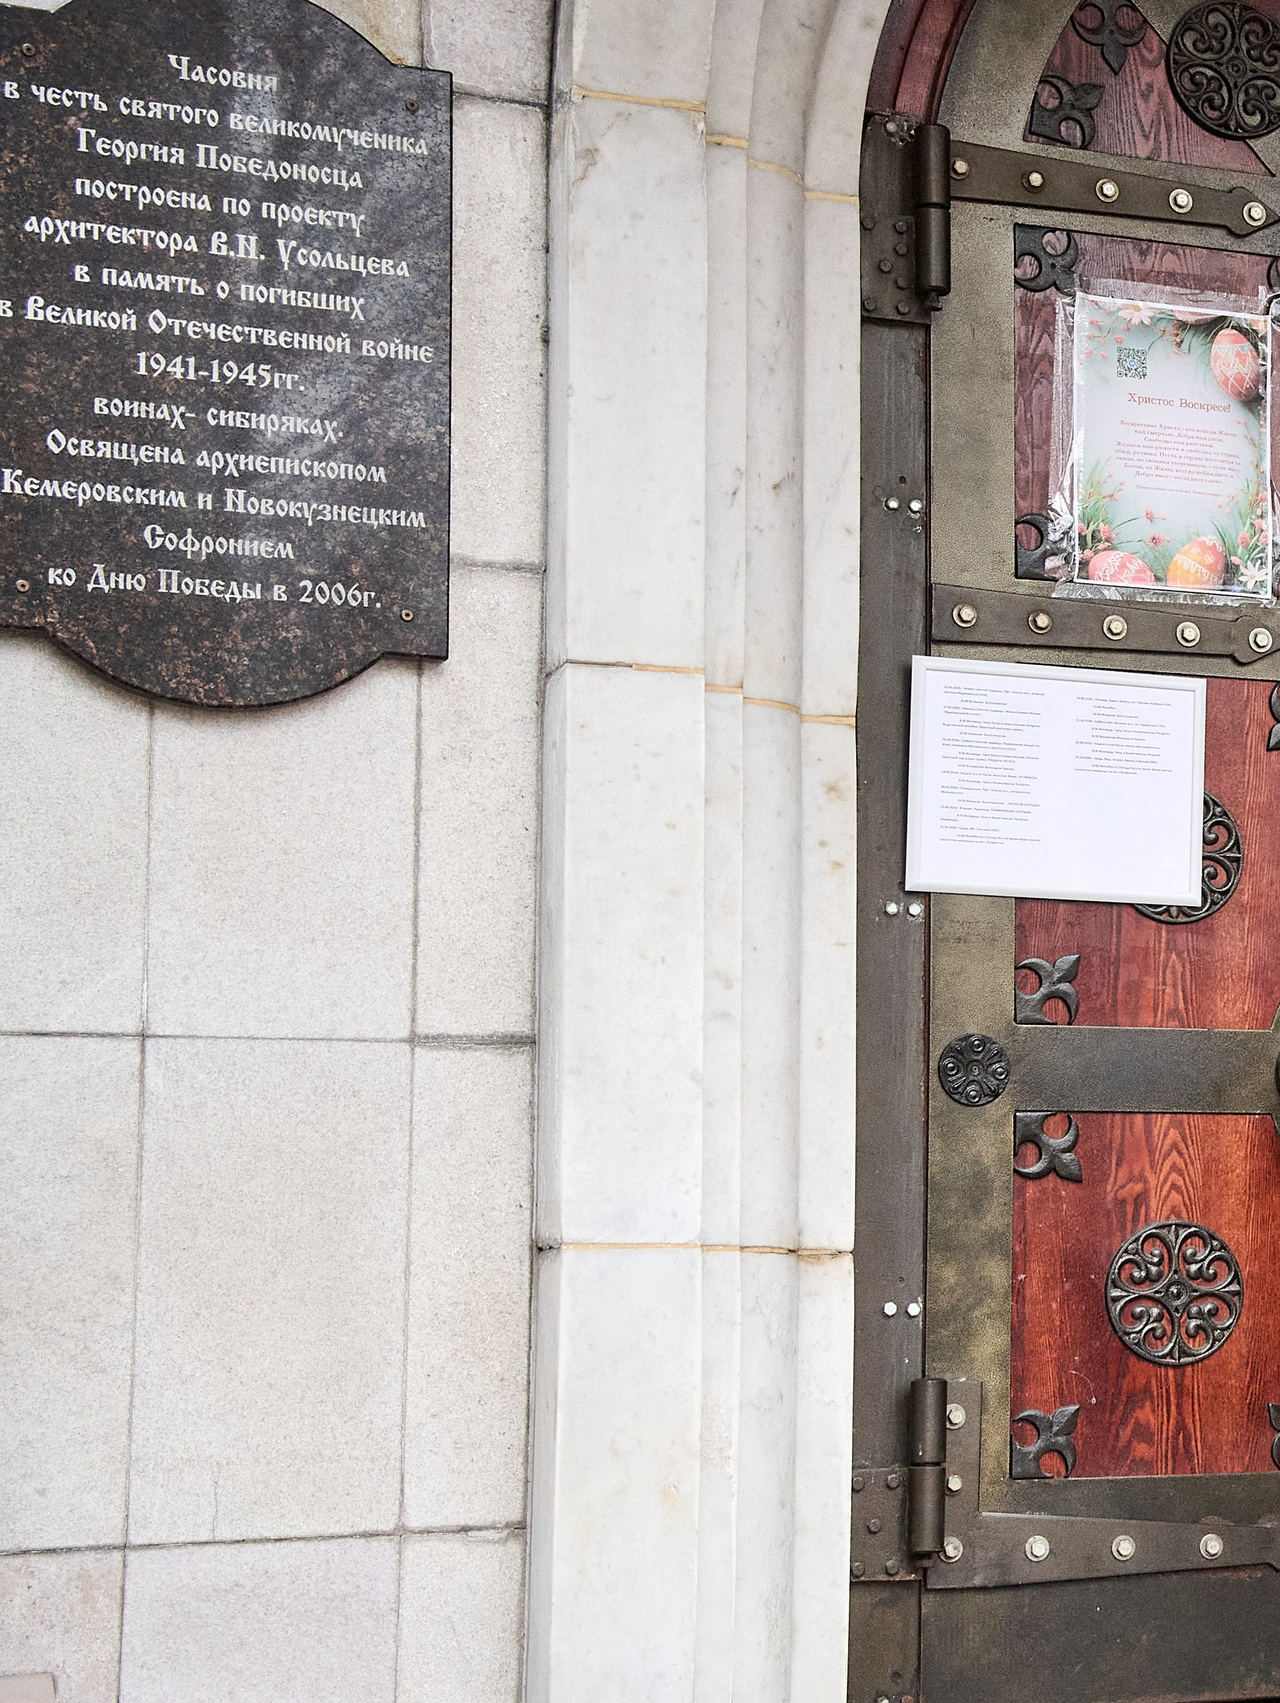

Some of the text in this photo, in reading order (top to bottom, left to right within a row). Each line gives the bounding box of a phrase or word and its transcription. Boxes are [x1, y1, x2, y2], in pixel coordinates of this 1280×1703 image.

[167, 53, 278, 93] Часовня
[2, 80, 429, 156] в честь святого великомученика
[76, 126, 364, 192] Георгия Победоносца
[75, 178, 366, 238] построена по проекту
[23, 215, 199, 258] архитектора
[275, 238, 410, 278] Усольцева
[73, 264, 365, 321] в память о погибших
[0, 295, 435, 364] в Великой Отечественной войне
[136, 351, 305, 393] 1941-1945гг.
[206, 407, 344, 444] сибиряках.
[1128, 393, 1231, 413] Христос Воскресе!
[45, 428, 388, 484] Освящена архиепископом
[0, 468, 427, 530] Кемеровским и Новокузнецким
[142, 524, 296, 562] Софронием
[47, 562, 382, 609] ко Дню Победы в 2006г.
